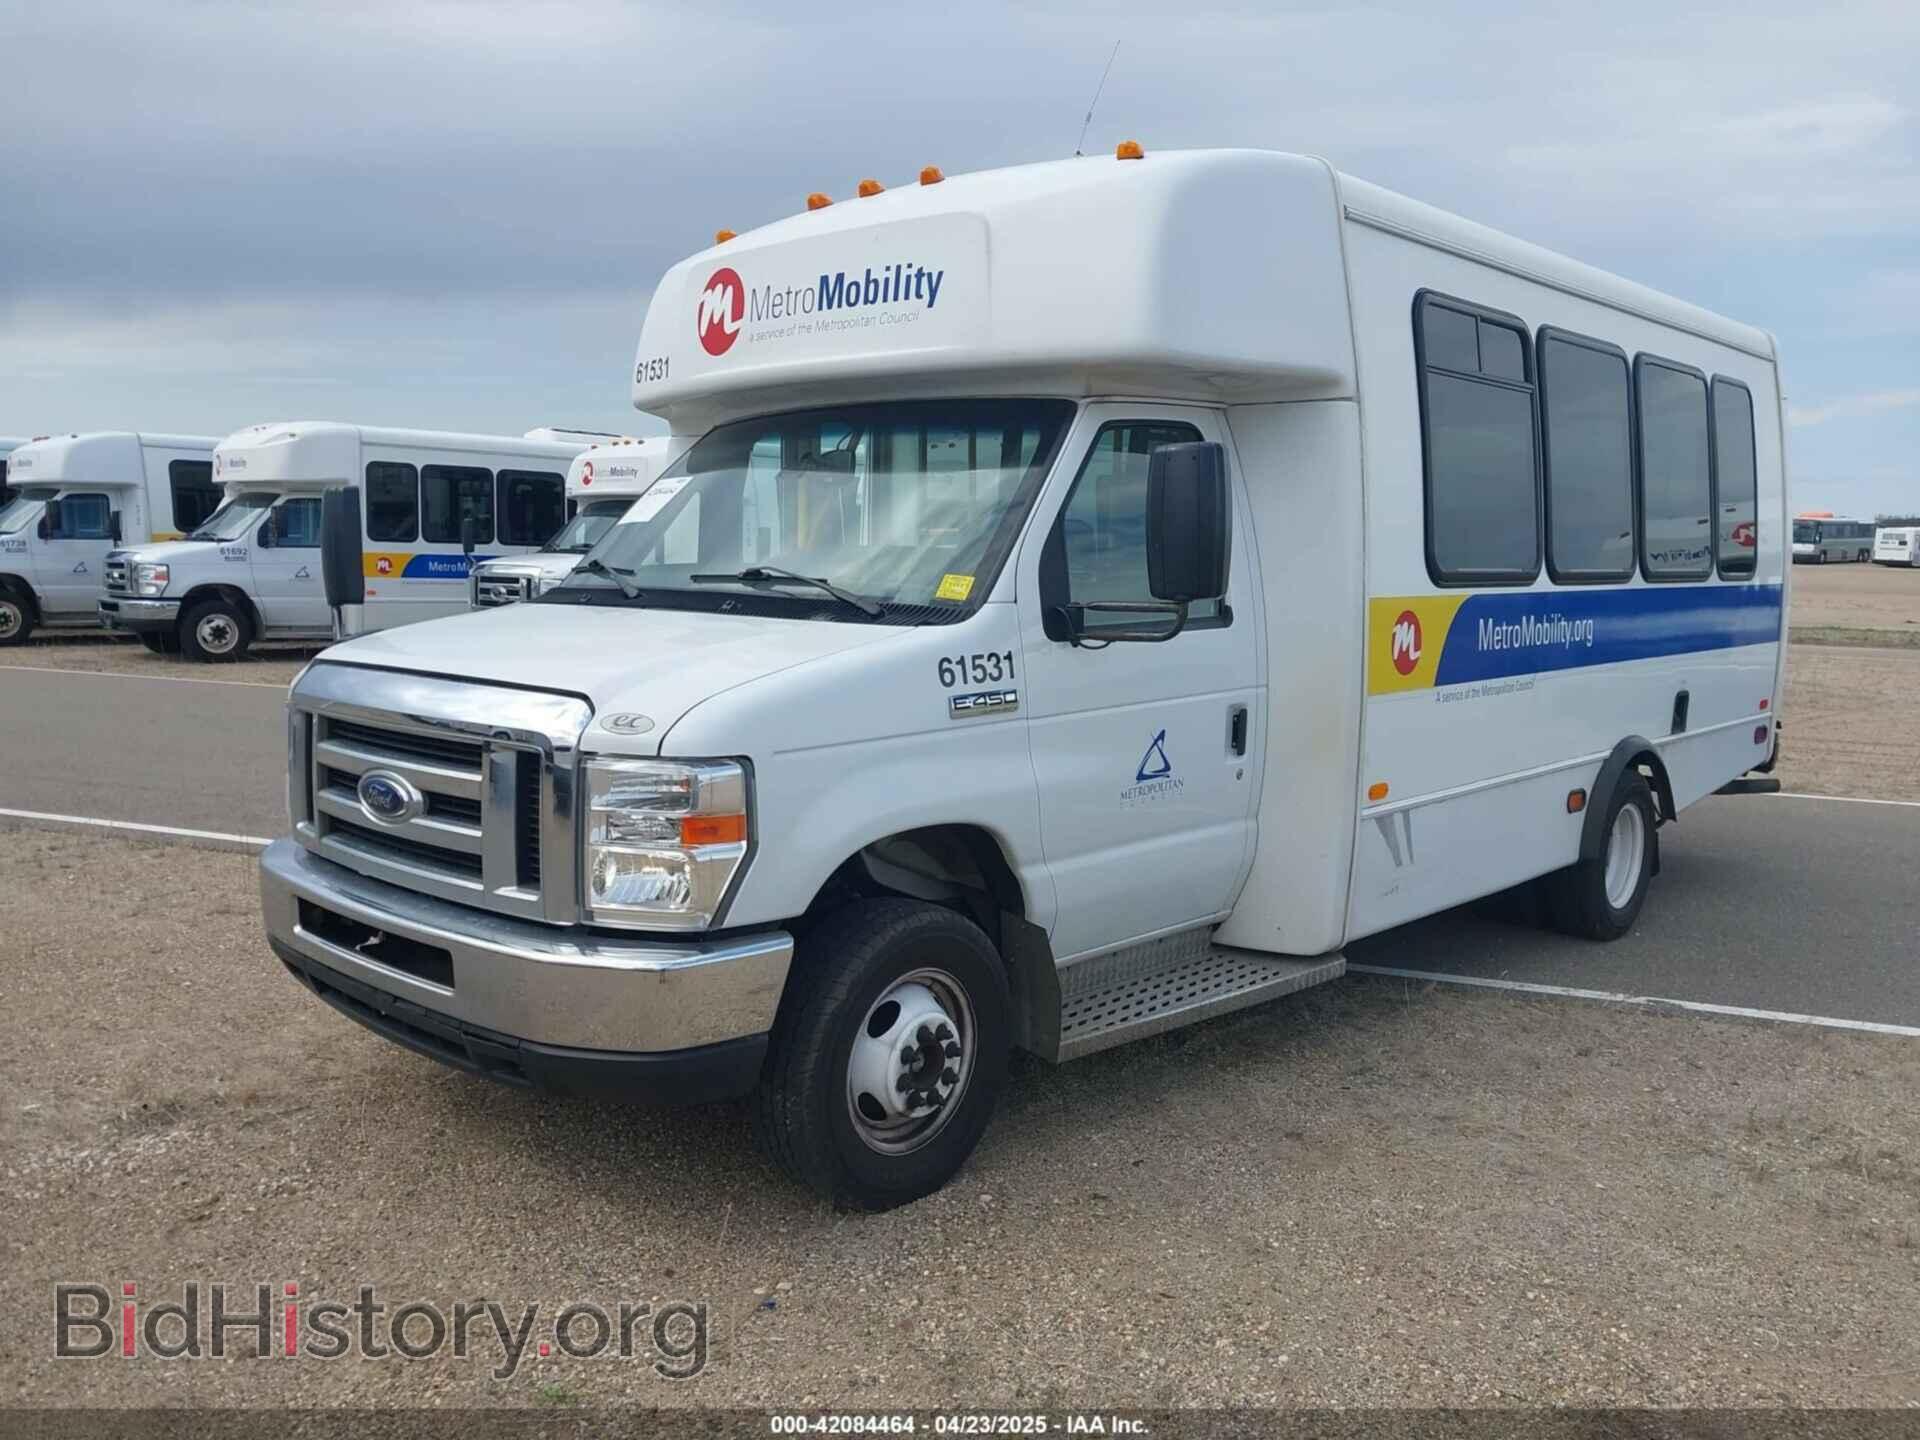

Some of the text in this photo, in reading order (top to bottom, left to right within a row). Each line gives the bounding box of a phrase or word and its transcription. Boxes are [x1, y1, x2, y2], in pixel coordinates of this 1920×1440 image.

[750, 262, 944, 323] MetroMobility
[755, 328, 785, 343] service
[786, 323, 797, 337] of
[815, 315, 877, 334] Metropolitan
[879, 310, 920, 326] Council
[636, 357, 670, 384] 61531
[1478, 613, 1595, 651] MetroMobility.org
[938, 650, 1015, 688] 61531
[1119, 777, 1184, 801] METROPOLITAN
